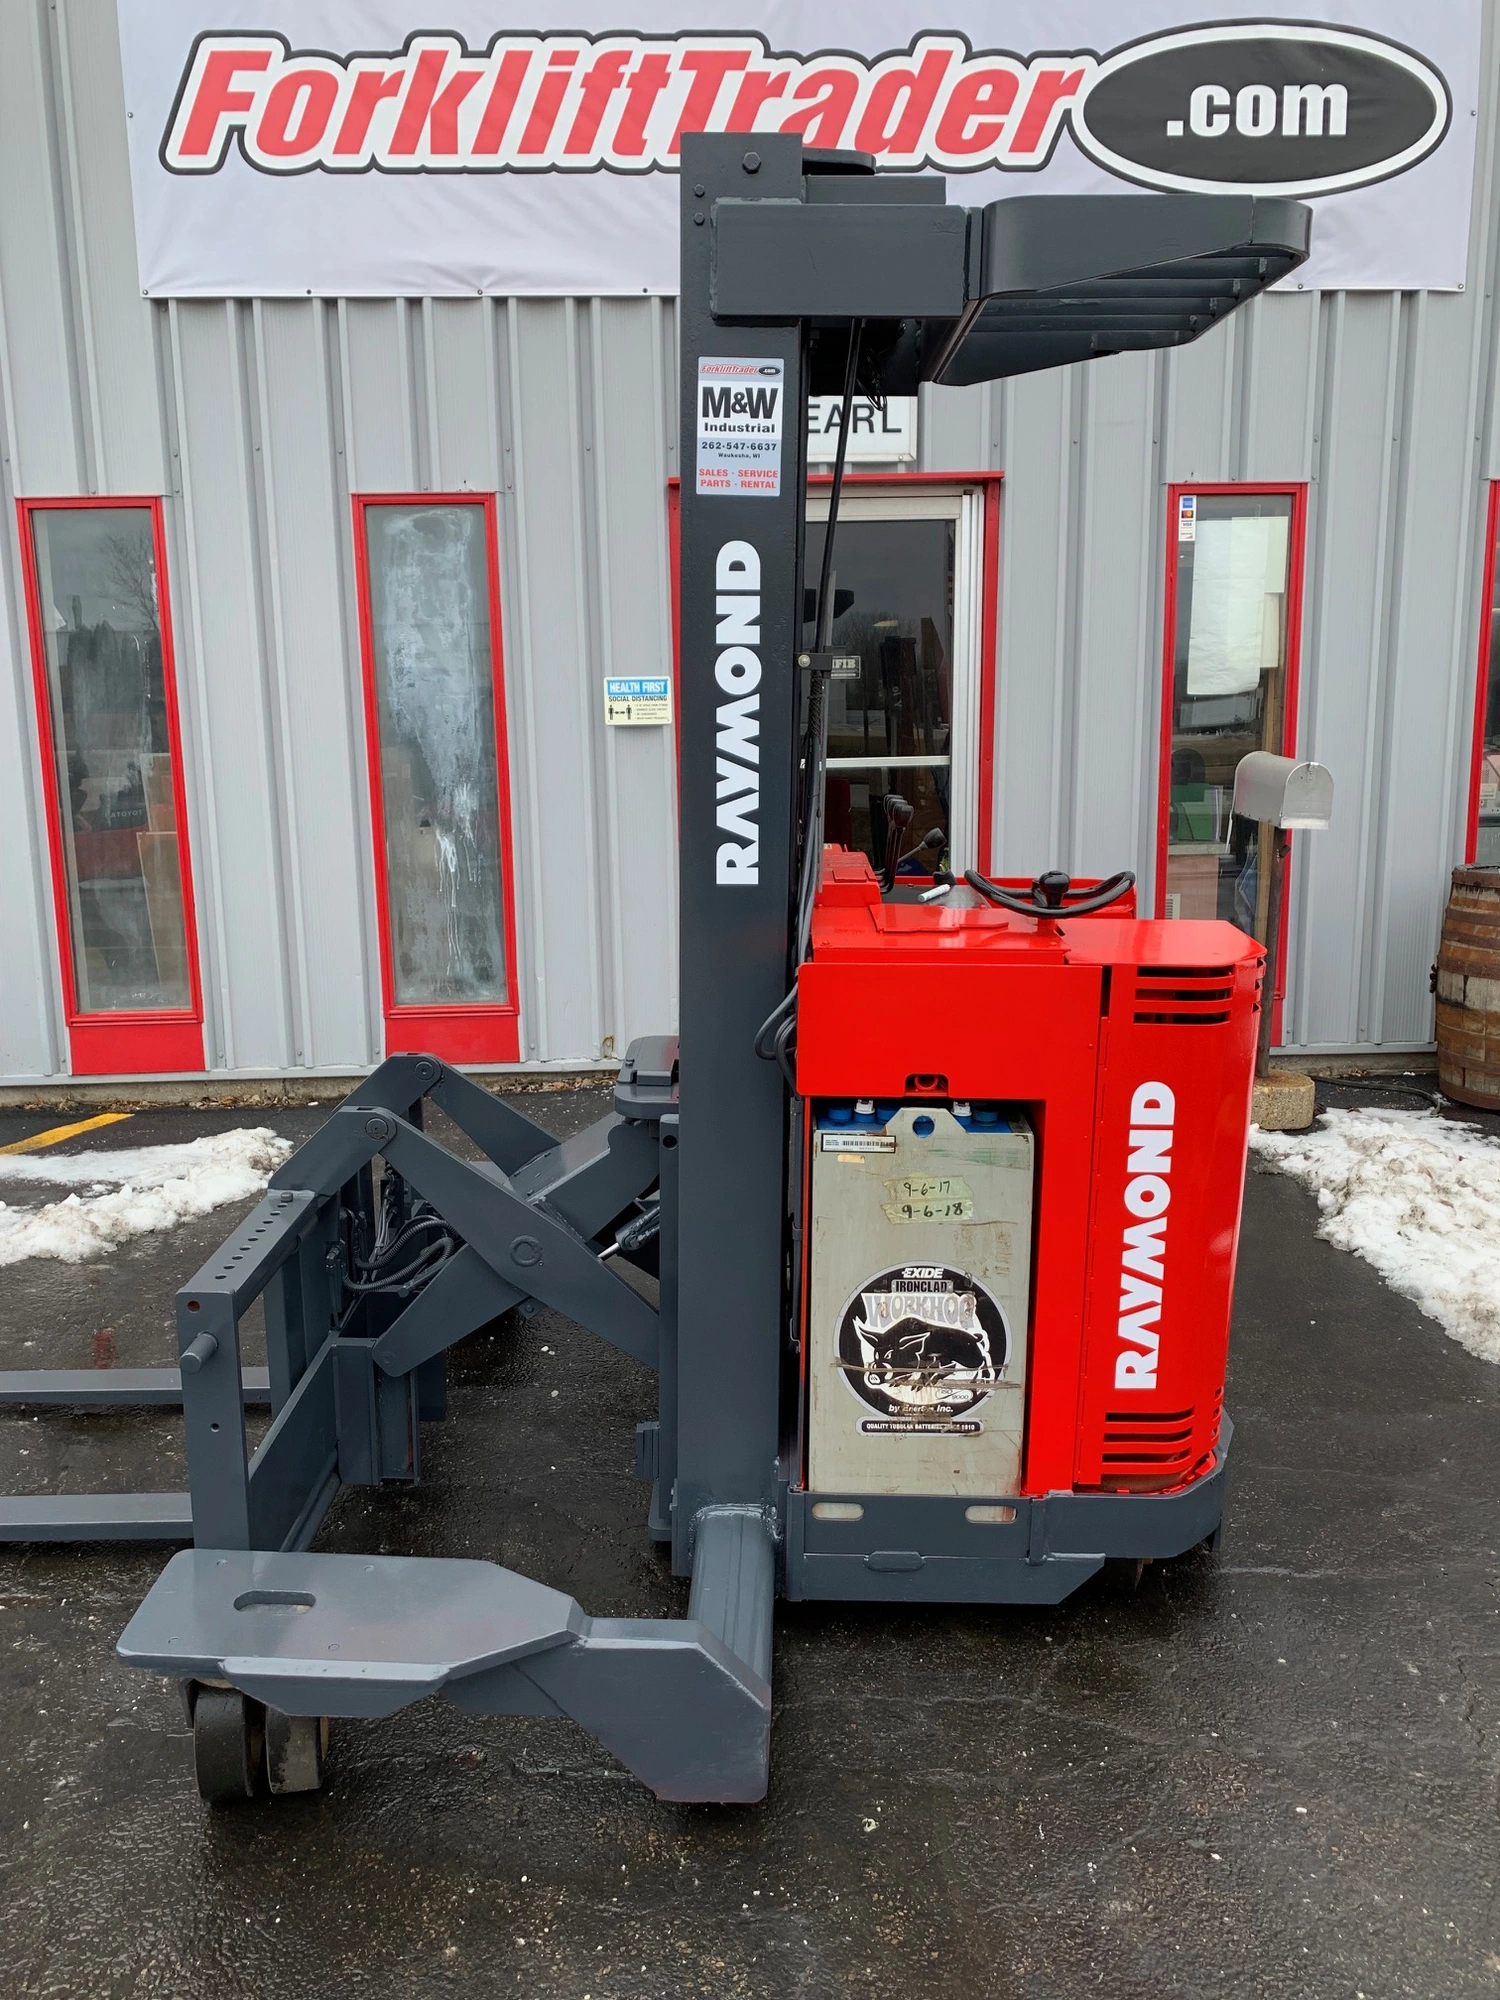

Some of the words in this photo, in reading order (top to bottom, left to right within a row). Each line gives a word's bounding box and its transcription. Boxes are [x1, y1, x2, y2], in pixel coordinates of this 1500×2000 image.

[177, 48, 1086, 157] ForkliftTrader
[1165, 81, 1348, 138] .com
[702, 386, 779, 420] M&W
[704, 422, 775, 433] Industrial
[698, 468, 729, 477] SALES
[737, 469, 779, 478] SERVICE
[700, 479, 731, 488] PARTS
[740, 480, 777, 489] RENTAL
[609, 681, 640, 693] HEALTH
[642, 681, 665, 693] FIRST
[714, 539, 762, 885] RAYMOND
[903, 1180, 951, 1197] 9-6-17
[901, 1202, 964, 1218] 9-6-18
[1114, 1080, 1176, 1389] RAYMOND
[901, 1267, 944, 1278] EXIDE
[895, 1281, 947, 1292] IRONCLAD
[888, 1404, 900, 1412] by
[936, 1404, 954, 1412] Inc.
